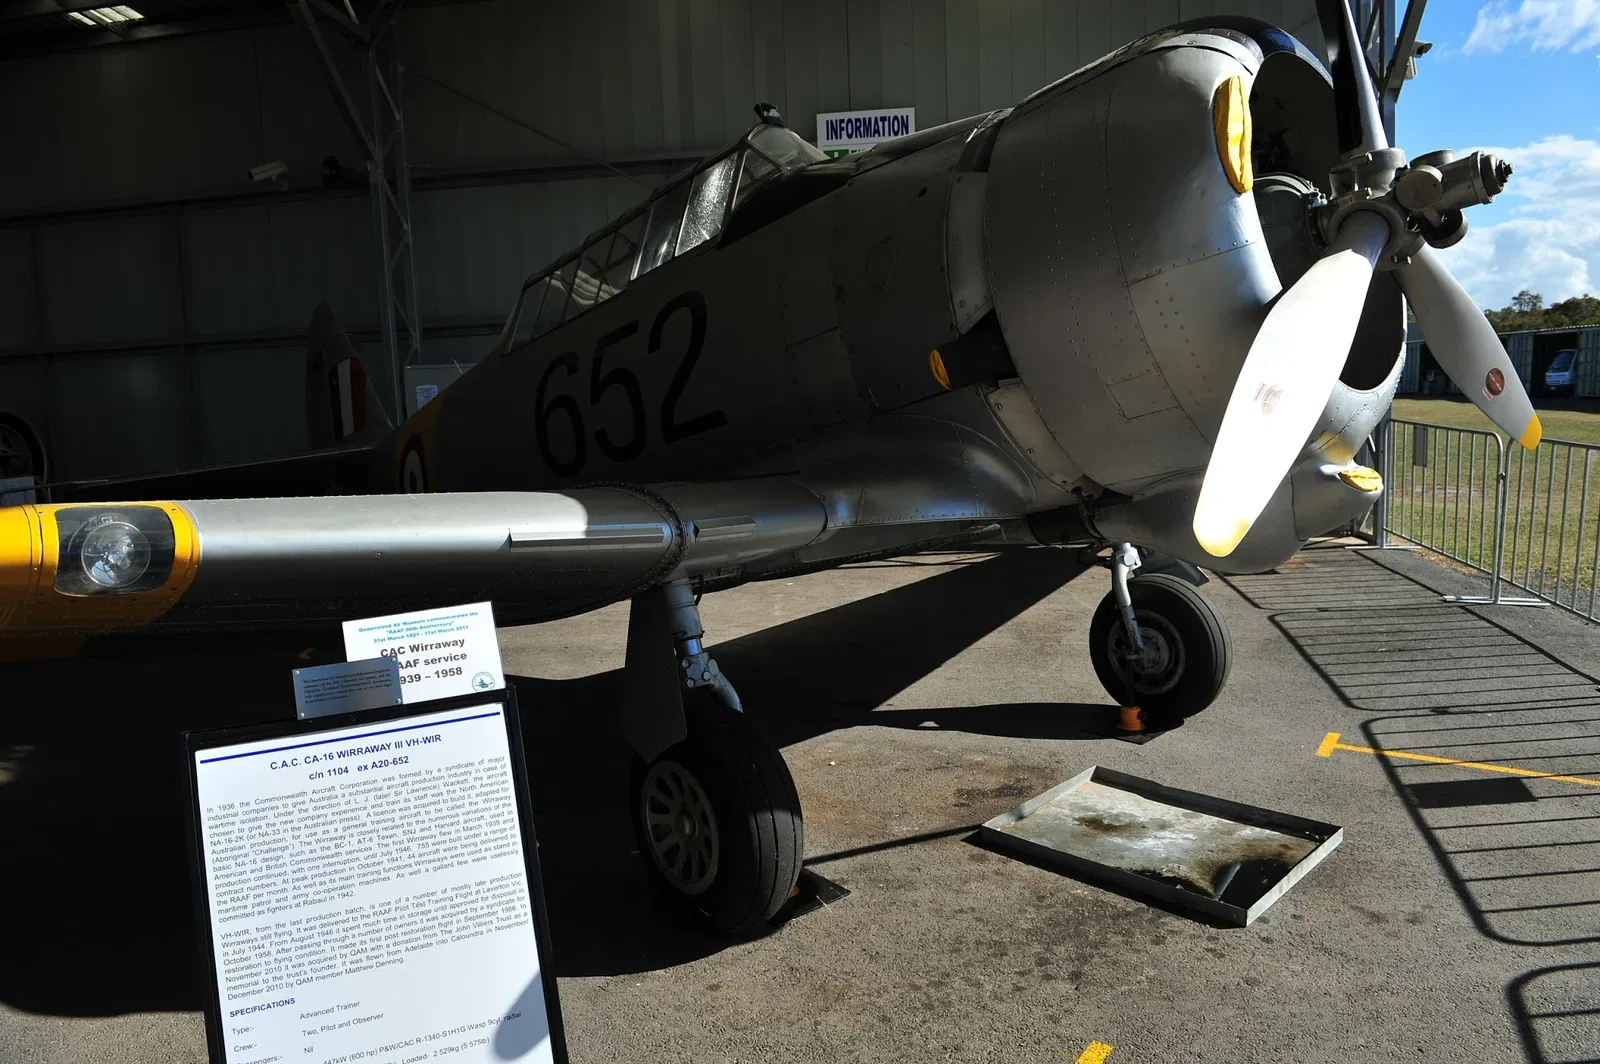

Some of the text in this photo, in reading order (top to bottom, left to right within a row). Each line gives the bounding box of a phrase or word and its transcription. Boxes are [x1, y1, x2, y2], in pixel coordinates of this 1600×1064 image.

[826, 115, 909, 141] INFORMATION
[534, 290, 729, 478] 652
[359, 624, 392, 632] Queensland
[427, 614, 468, 622] commemorates
[380, 639, 465, 657] CAC Wirraway
[398, 653, 467, 669] AAF service
[400, 673, 421, 684] 939
[434, 667, 463, 679] 1958
[269, 733, 441, 770] C.A.C. CA-16 WIRRAWAY III VH-WIR
[308, 755, 409, 780] c/n 1104 ex A20-652
[218, 802, 235, 811] 1936
[254, 790, 307, 805] Commonwealth
[311, 785, 335, 795] Aircraft
[339, 779, 378, 790] Corporation
[398, 770, 421, 779] formed
[444, 761, 474, 772] syndicate
[210, 844, 246, 855] Australian
[249, 837, 288, 849] production,
[341, 820, 367, 832] general
[370, 816, 395, 826] training
[398, 811, 421, 820] aircraft
[446, 802, 465, 811] called
[481, 795, 511, 804] Wirraway
[212, 864, 231, 872] basic
[234, 858, 257, 868] NA-16
[260, 854, 285, 863] design,
[288, 850, 305, 858] such
[334, 840, 353, 849] BC-1,
[356, 836, 373, 844] AT-6
[402, 828, 416, 836] SNJ
[434, 819, 460, 829] Harvard
[489, 810, 504, 819] used
[218, 910, 255, 923] committed
[266, 904, 292, 914] fighters
[302, 895, 327, 906] Rabaul
[337, 890, 355, 899] 1942.
[220, 928, 251, 940] VH-WIR,
[289, 918, 302, 926] last
[305, 911, 342, 924] production
[344, 906, 364, 915] batch,
[394, 896, 401, 904] of
[412, 890, 437, 900] number
[450, 883, 471, 892] mostly
[489, 872, 522, 884] production
[230, 948, 245, 956] July
[248, 943, 267, 952] 1944.
[269, 939, 287, 947] From
[289, 933, 314, 943] August
[316, 928, 333, 937] 1946
[341, 923, 360, 933] spent
[362, 919, 380, 927] much
[407, 908, 431, 919] storage
[433, 904, 447, 912] until
[449, 897, 479, 909] approved
[490, 888, 517, 900] disposal
[227, 987, 264, 1001] December
[265, 982, 283, 992] 2010
[295, 975, 313, 986] QAM
[314, 970, 343, 981] member
[344, 964, 374, 975] Matthew
[375, 957, 405, 968] Denning.
[229, 997, 295, 1018] SPECIFICATIONS
[299, 1001, 360, 1020] Advanced Trainer
[301, 1013, 383, 1037] Two, Pilot and Observer
[349, 1052, 365, 1062] (600
[366, 1049, 378, 1058] hp)
[380, 1039, 415, 1053] P&W/CAC
[416, 1026, 466, 1043] R-1340-S1H1G
[467, 1021, 487, 1031] Wasp
[504, 1012, 521, 1021] radial
[303, 1046, 313, 1054] Nil
[402, 1053, 430, 1064] Loaded-
[440, 1045, 459, 1055] 529kg
[461, 1042, 468, 1051] (5
[469, 1037, 490, 1047] 575lb)
